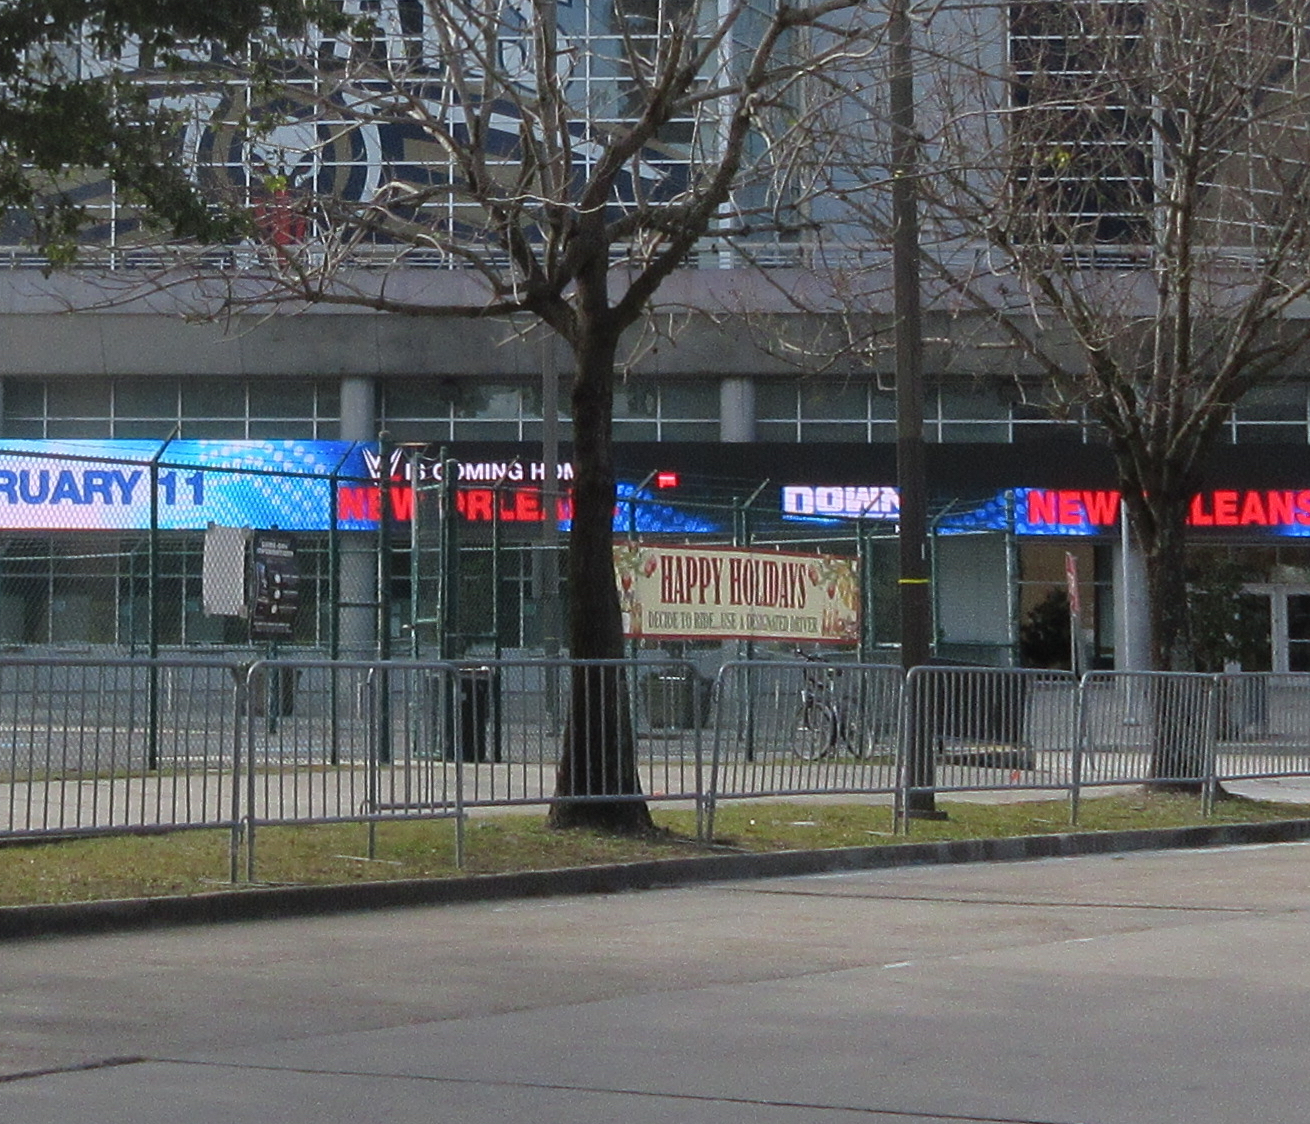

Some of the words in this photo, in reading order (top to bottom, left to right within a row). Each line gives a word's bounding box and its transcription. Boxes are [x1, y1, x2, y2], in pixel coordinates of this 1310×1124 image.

[158, 471, 205, 506] 11
[337, 486, 424, 522] NEW
[1027, 490, 1120, 526] NEW
[660, 555, 723, 605] HAPPY
[729, 557, 808, 609] HOLIDAYS
[648, 610, 677, 628] DECIDE
[681, 611, 692, 628] TO
